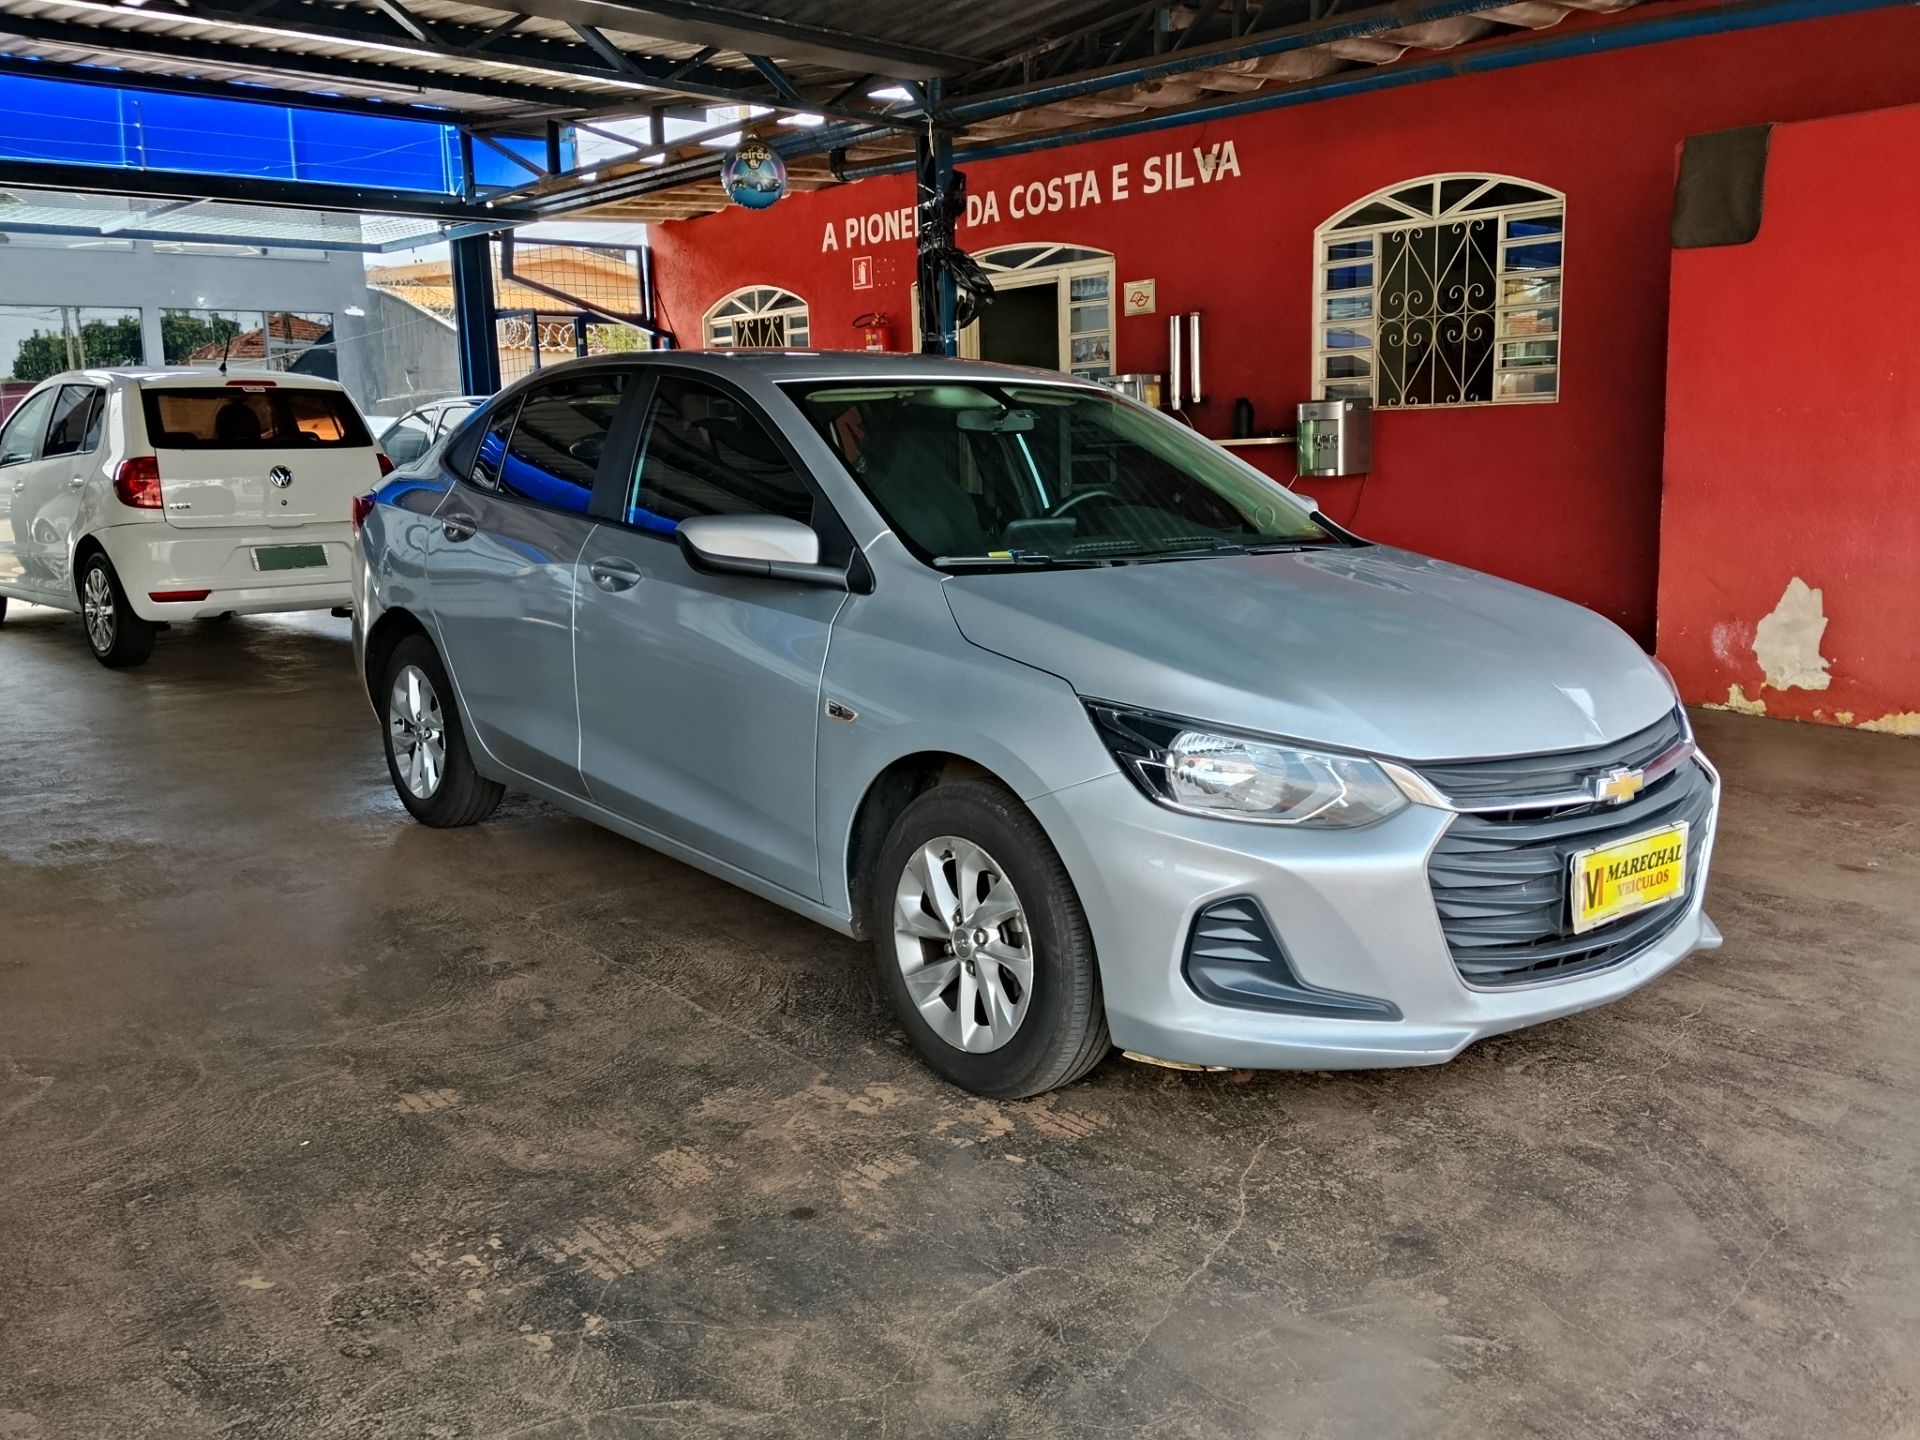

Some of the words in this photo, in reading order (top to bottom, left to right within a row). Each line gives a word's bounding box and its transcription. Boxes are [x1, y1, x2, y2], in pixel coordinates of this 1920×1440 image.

[736, 149, 772, 161] Feirão
[822, 222, 839, 252] A
[966, 190, 1001, 227] DA
[1009, 169, 1102, 219] COSTA
[1112, 162, 1129, 201] E
[1143, 140, 1241, 194] SILVA
[1606, 844, 1683, 883] MARECHAL
